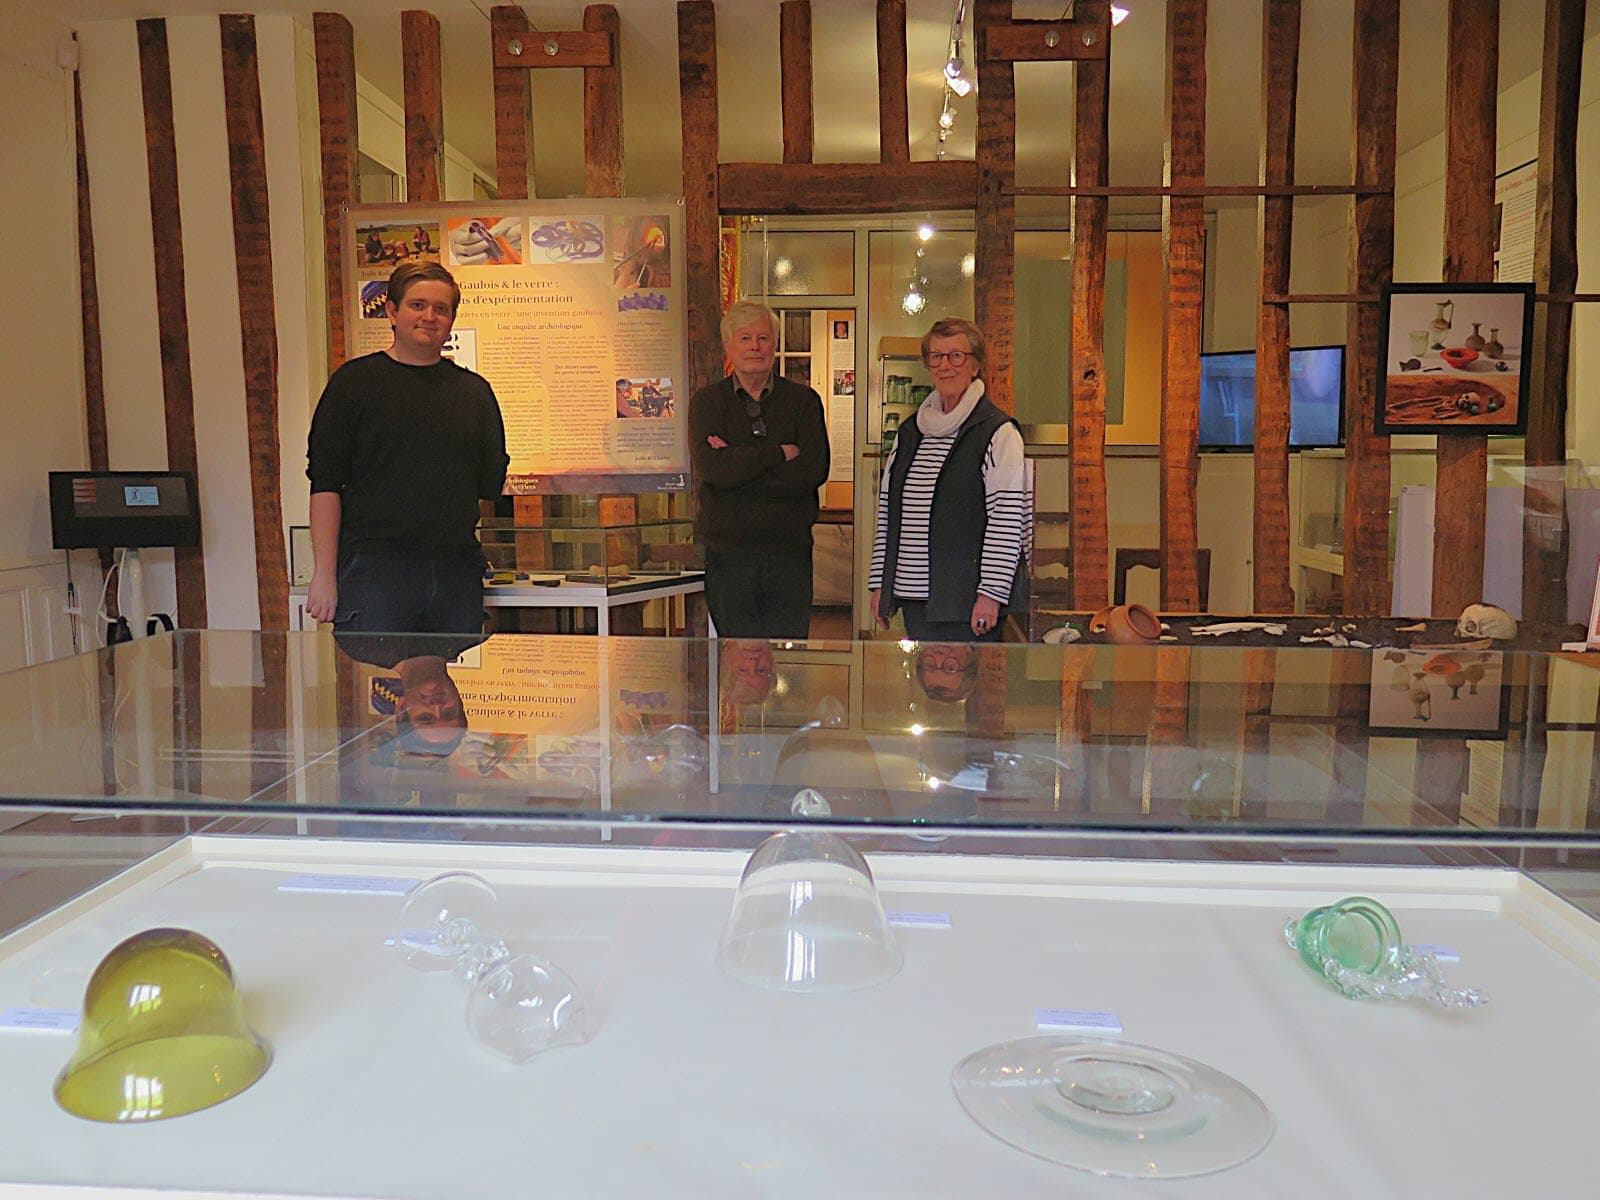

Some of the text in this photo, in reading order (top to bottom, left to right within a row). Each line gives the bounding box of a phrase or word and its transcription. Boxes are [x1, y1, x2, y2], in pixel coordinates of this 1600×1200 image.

[459, 280, 499, 290] Gaulois
[501, 280, 510, 289] &
[512, 279, 521, 289] le
[523, 281, 553, 289] verre
[460, 293, 573, 307] ns d'expérimentation
[533, 309, 570, 317] invention
[497, 322, 583, 332] Une enquête archéologique
[509, 477, 539, 485] héologues
